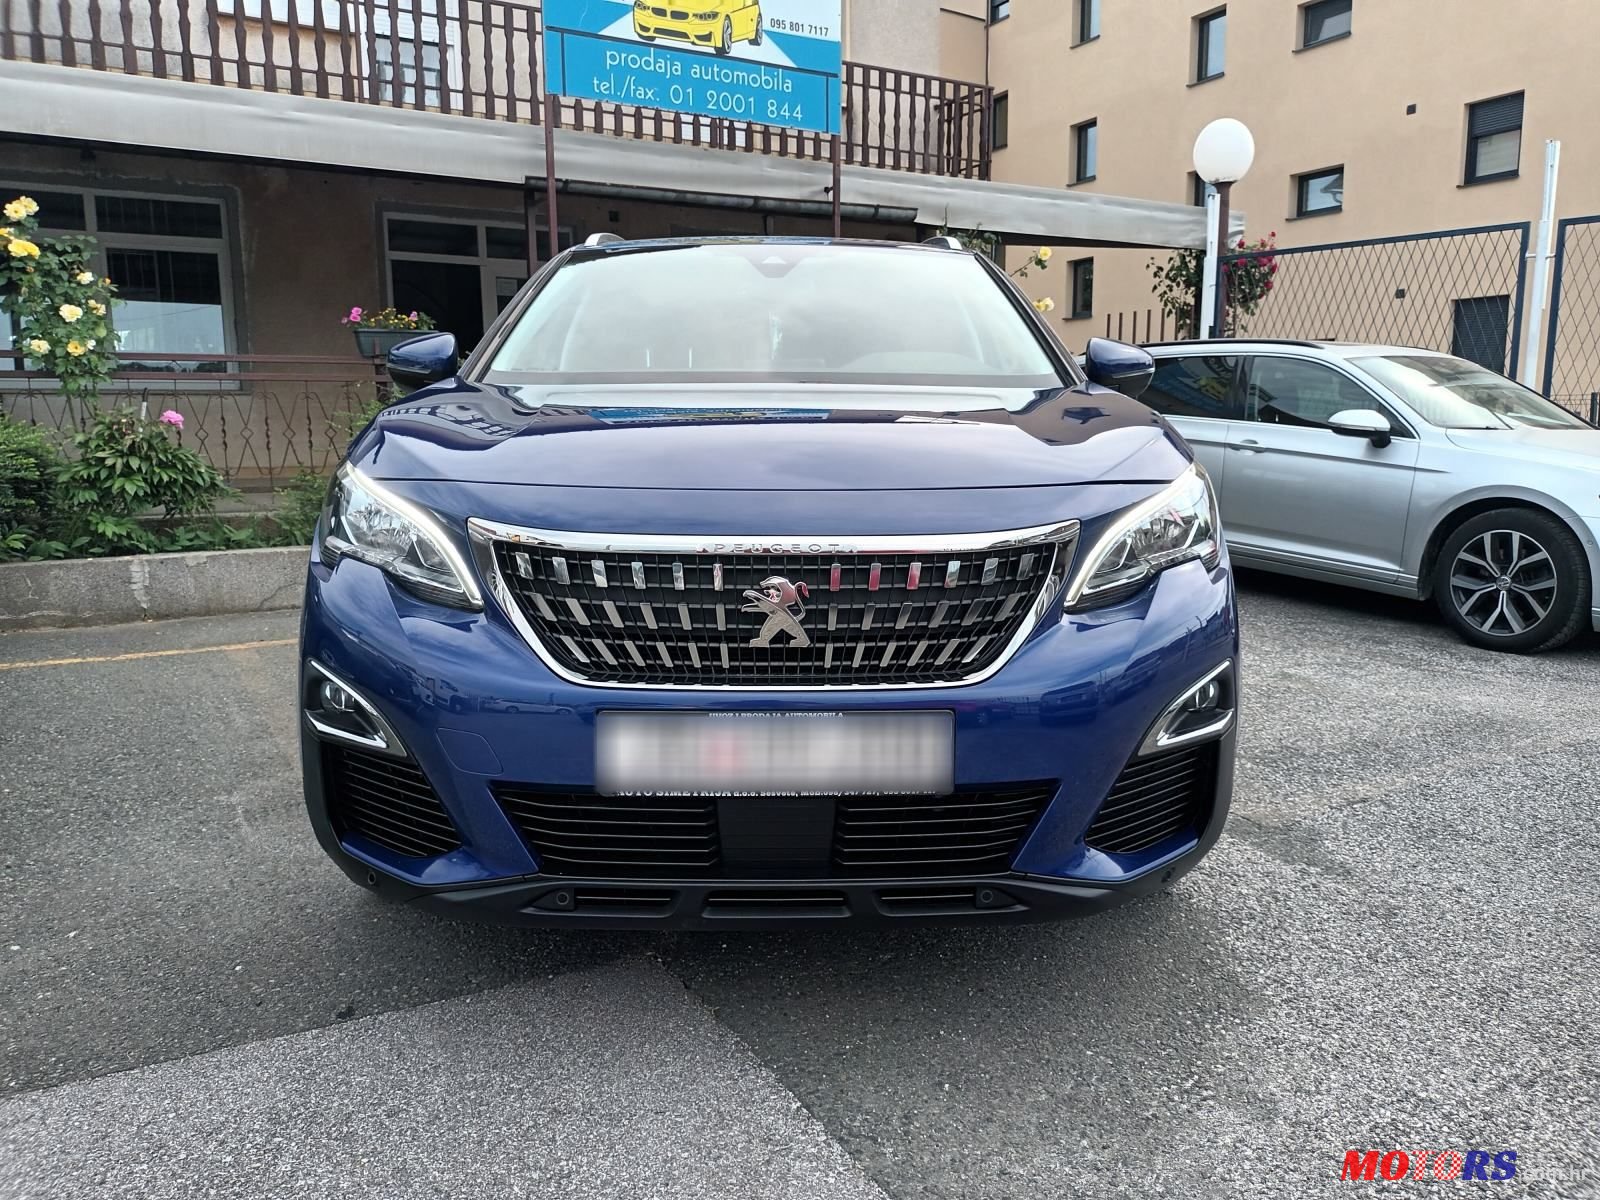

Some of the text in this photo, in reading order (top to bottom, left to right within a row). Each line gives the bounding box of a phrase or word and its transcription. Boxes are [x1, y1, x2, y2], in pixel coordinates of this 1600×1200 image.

[770, 18, 829, 37] 095 801 7117
[606, 47, 793, 94] prodaja automobila
[593, 73, 803, 122] tel./fax. 01 2001 844
[714, 543, 840, 554] PEUGEOT
